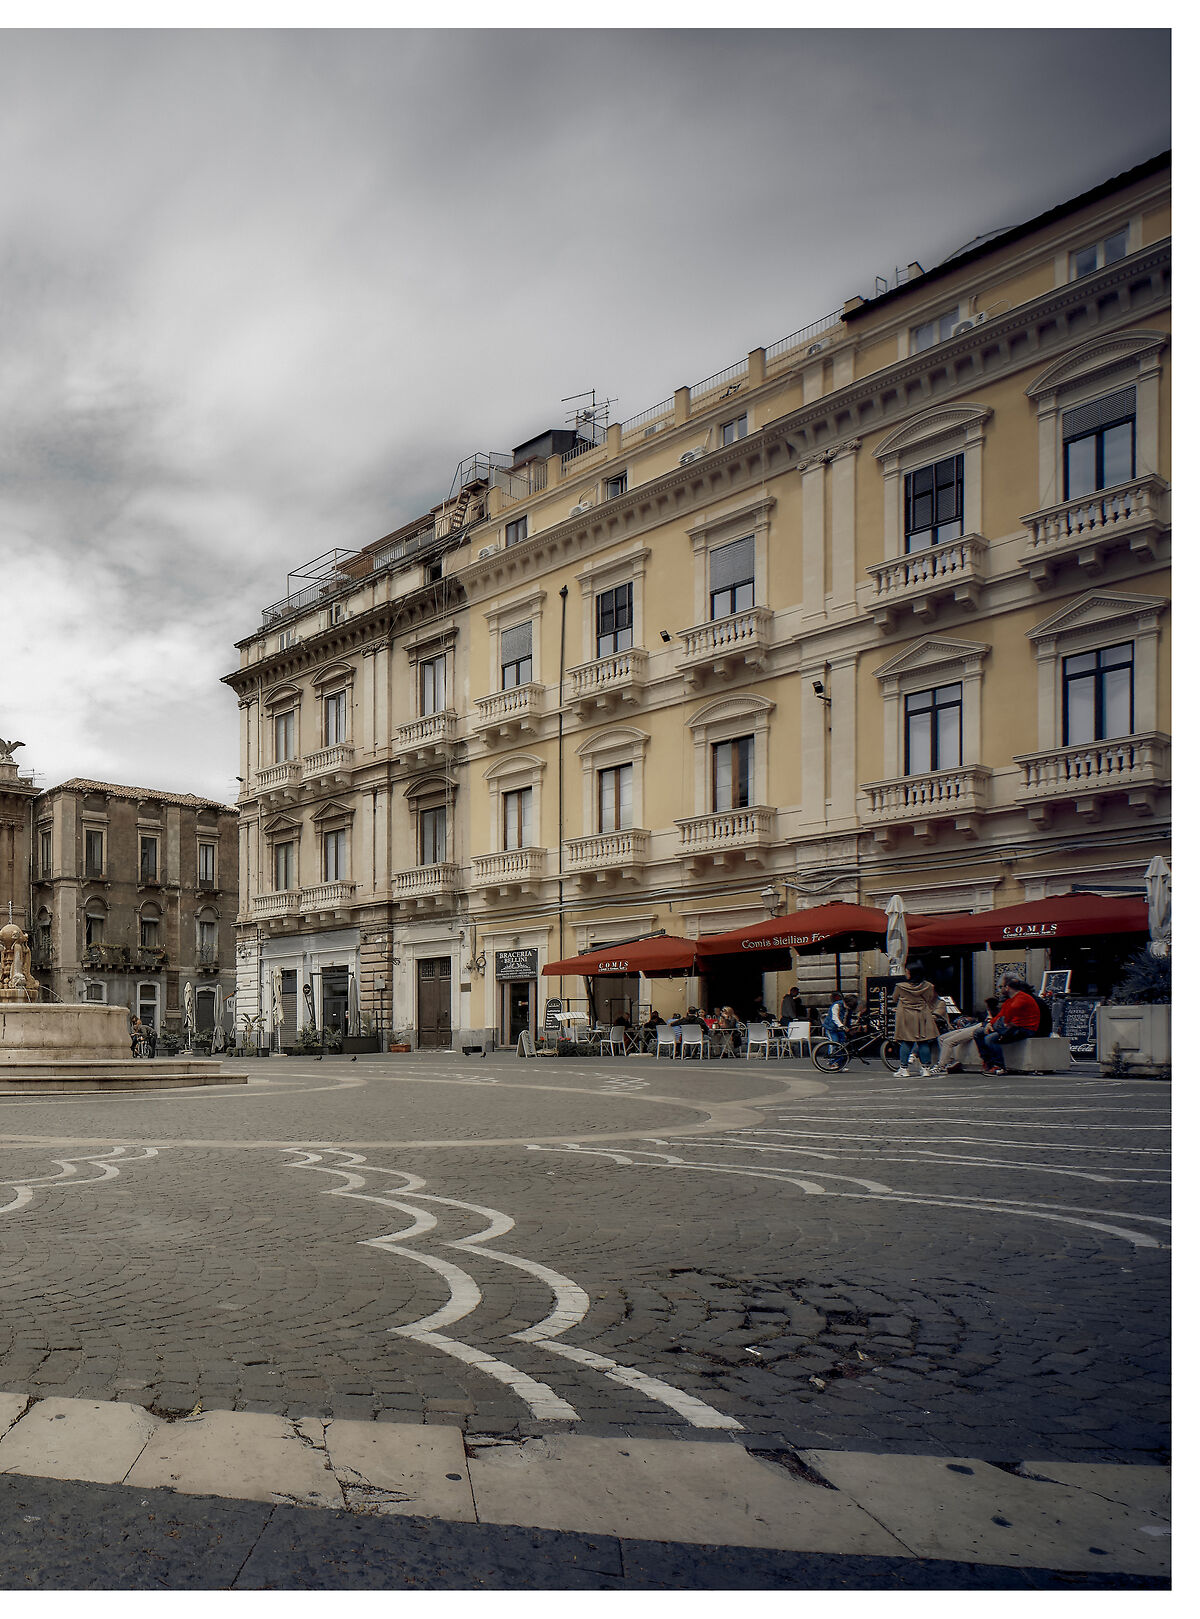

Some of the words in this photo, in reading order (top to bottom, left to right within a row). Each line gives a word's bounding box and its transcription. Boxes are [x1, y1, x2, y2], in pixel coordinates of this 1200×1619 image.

[1003, 924, 1057, 934] COMIS
[741, 939, 771, 949] Comis
[773, 935, 809, 946] Sicilian
[499, 950, 533, 959] BRACERIA
[598, 960, 629, 969] COMIS
